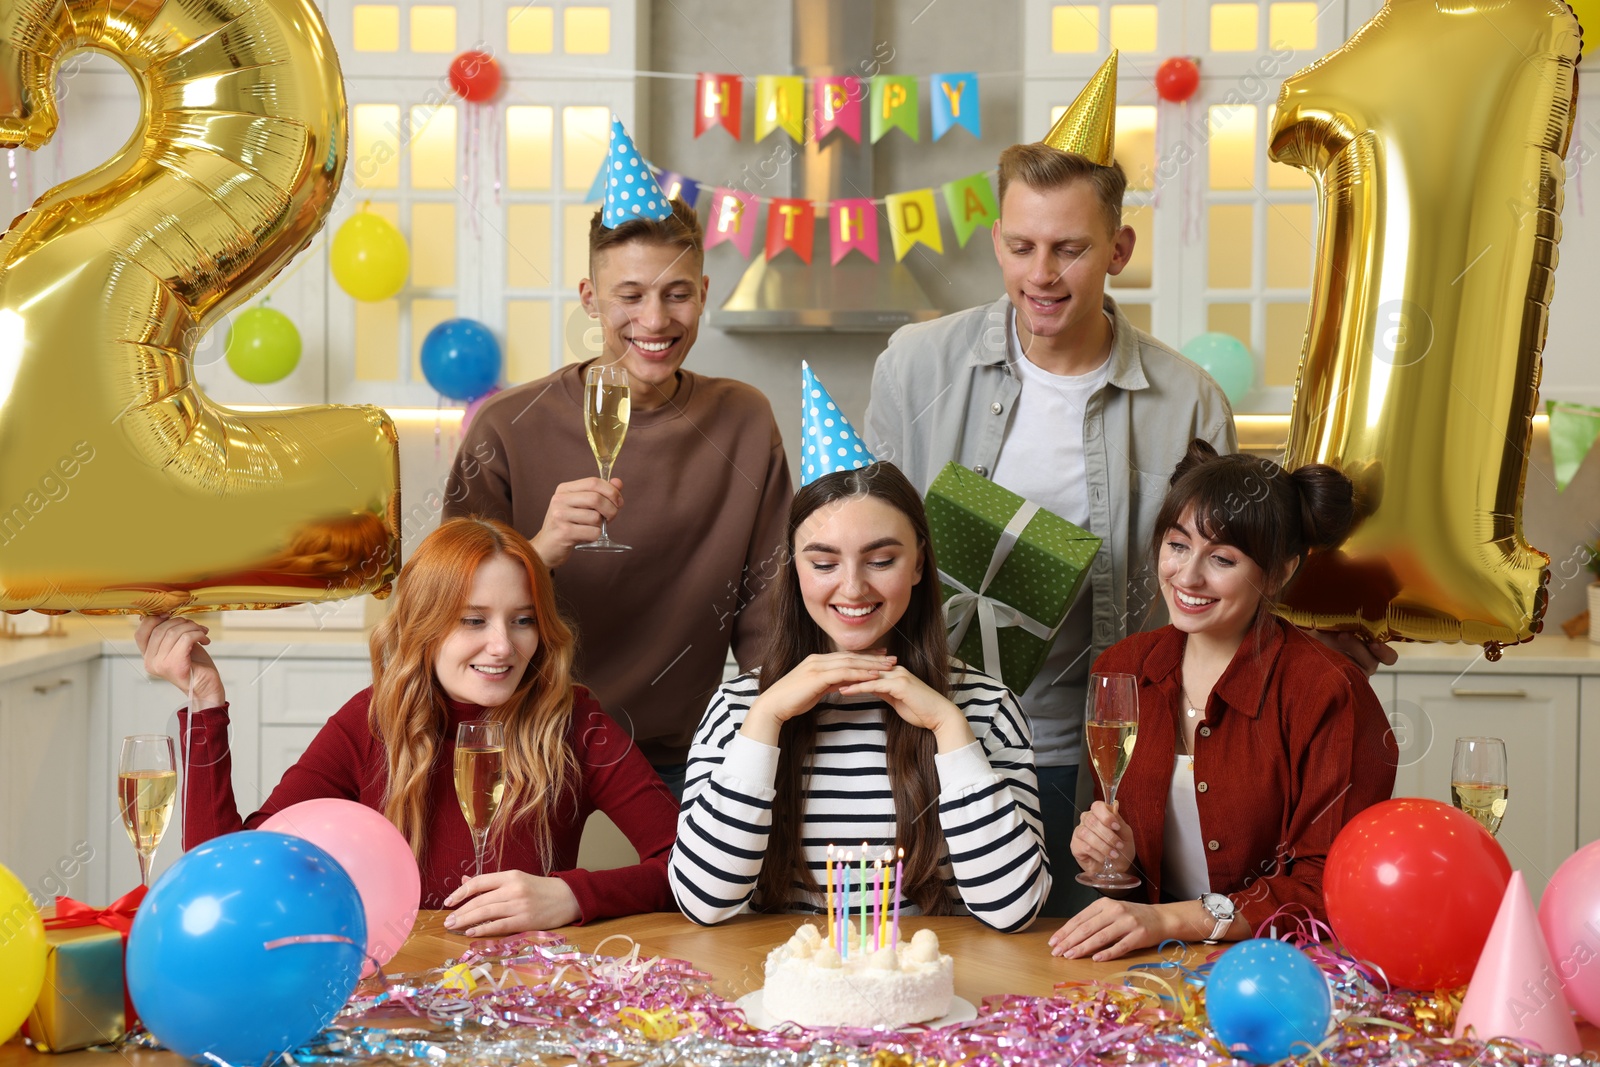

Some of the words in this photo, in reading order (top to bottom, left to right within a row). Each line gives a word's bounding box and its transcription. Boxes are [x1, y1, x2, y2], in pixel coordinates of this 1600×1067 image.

[0, 0, 400, 614] 2
[704, 80, 966, 122] HAPPY
[1269, 0, 1582, 660] 1
